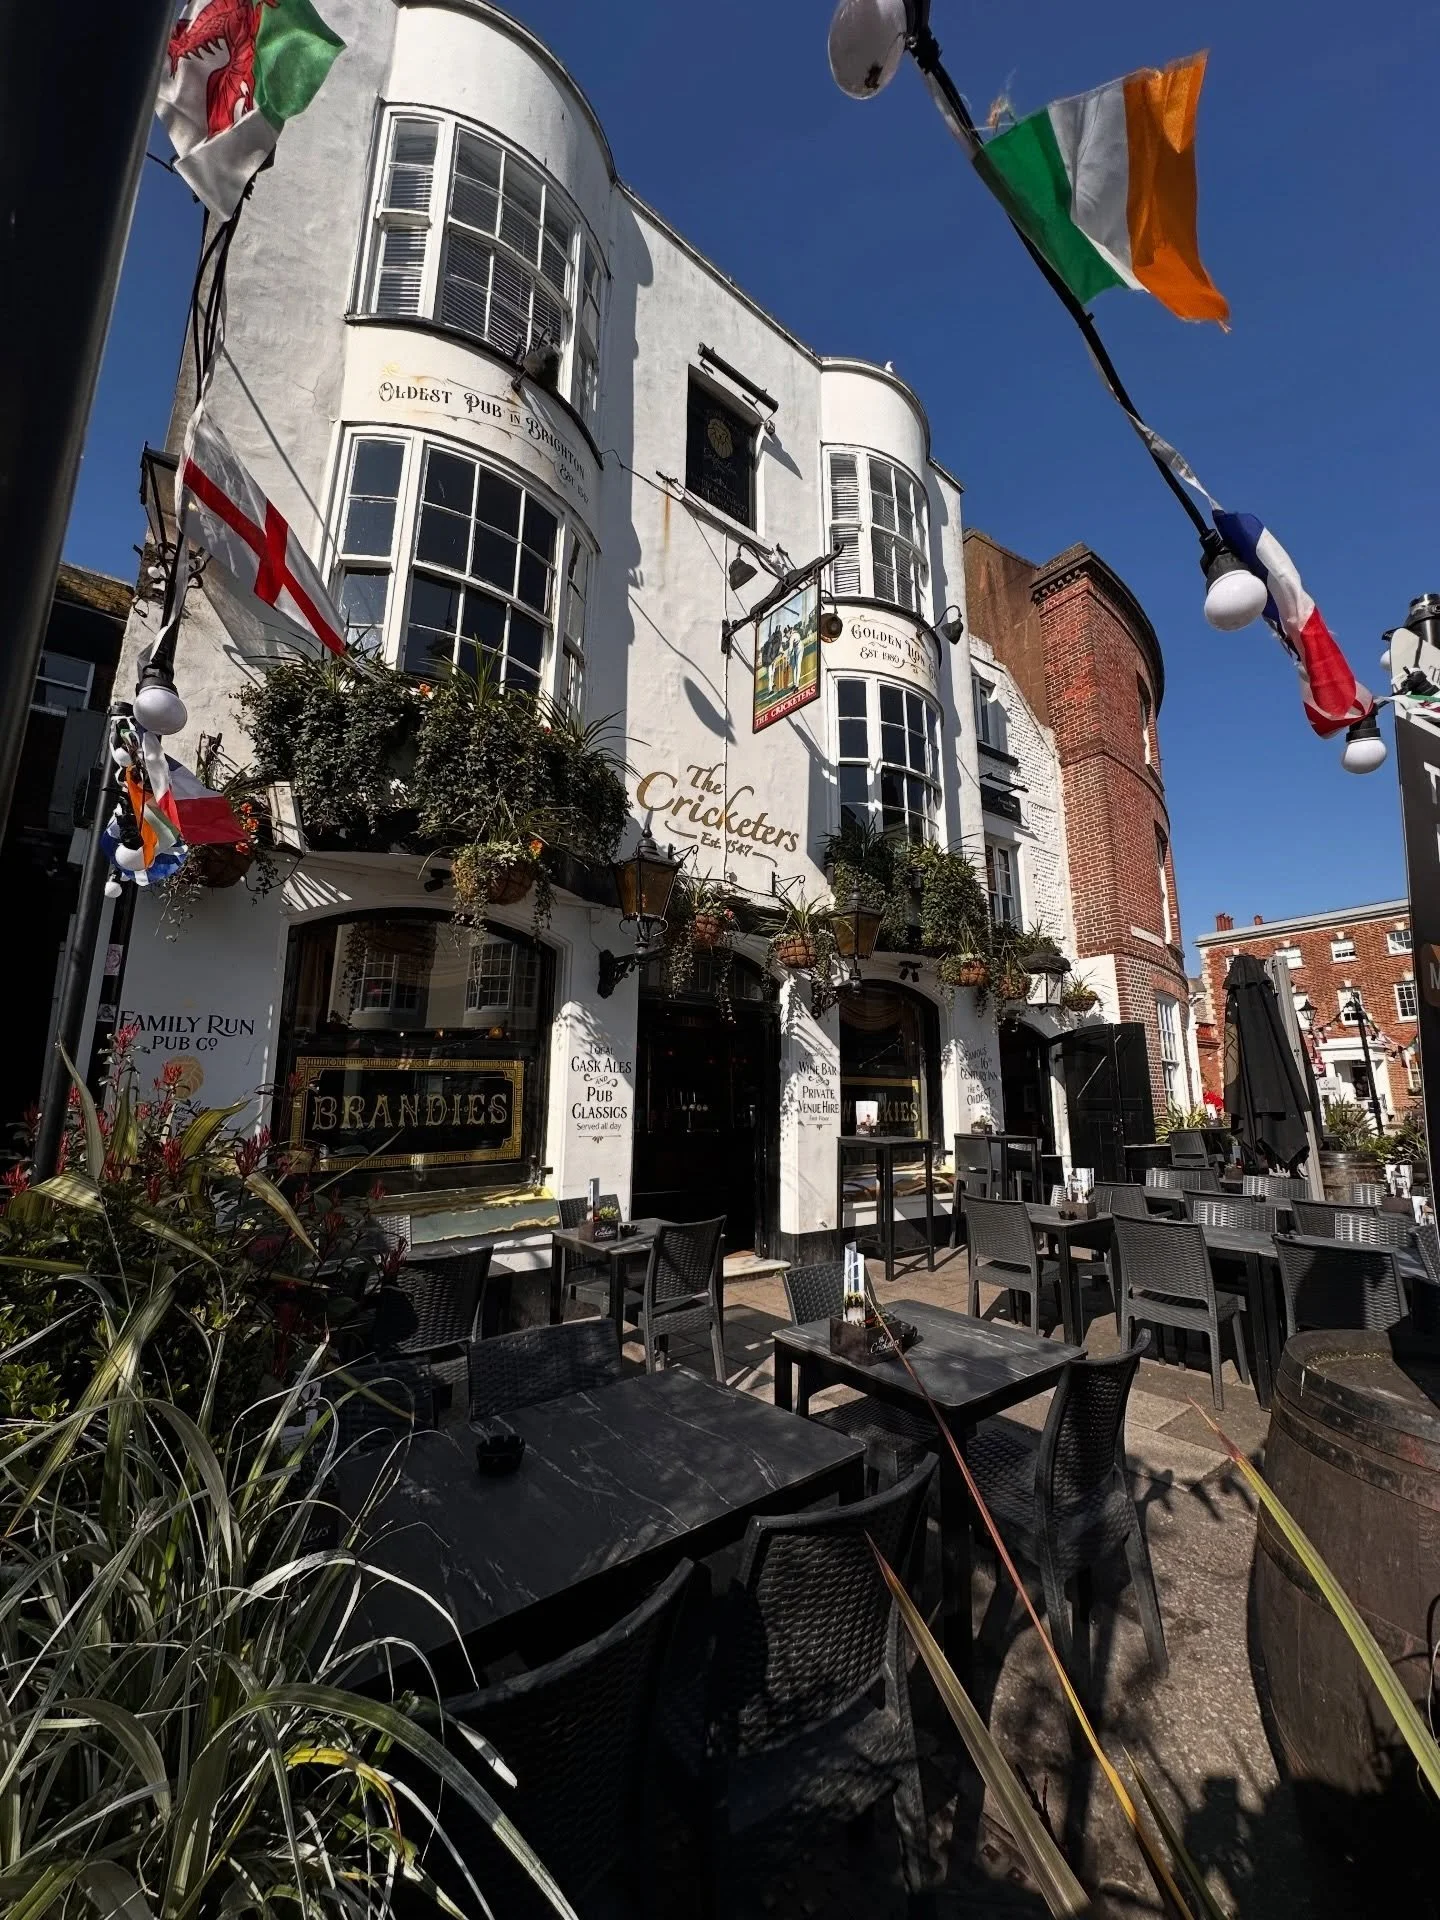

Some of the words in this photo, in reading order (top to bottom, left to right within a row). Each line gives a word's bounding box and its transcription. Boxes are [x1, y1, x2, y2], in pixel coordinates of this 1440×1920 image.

[379, 382, 452, 404] OLDEST
[464, 392, 502, 416] PUB
[510, 413, 521, 425] IN
[526, 417, 585, 481] BRIGHTON
[850, 623, 902, 652] GOLDEN
[755, 711, 769, 728] THE
[770, 685, 816, 717] CRICKETERS
[686, 763, 727, 795] The
[637, 771, 799, 853] Cricketers
[726, 840, 753, 857] 1547
[118, 1010, 202, 1033] FAMILY
[207, 1014, 255, 1037] RUN
[152, 1035, 190, 1051] PUB
[571, 1056, 601, 1073] CASK
[604, 1057, 632, 1073] ALES
[822, 1062, 837, 1076] BAR
[587, 1086, 613, 1102] PUB
[803, 1086, 835, 1099] PRIVATE
[312, 1093, 508, 1131] BRANDIES
[572, 1103, 628, 1119] CLASSICS
[823, 1101, 840, 1113] HIRE
[577, 1122, 600, 1131] Served
[610, 1122, 622, 1131] day
